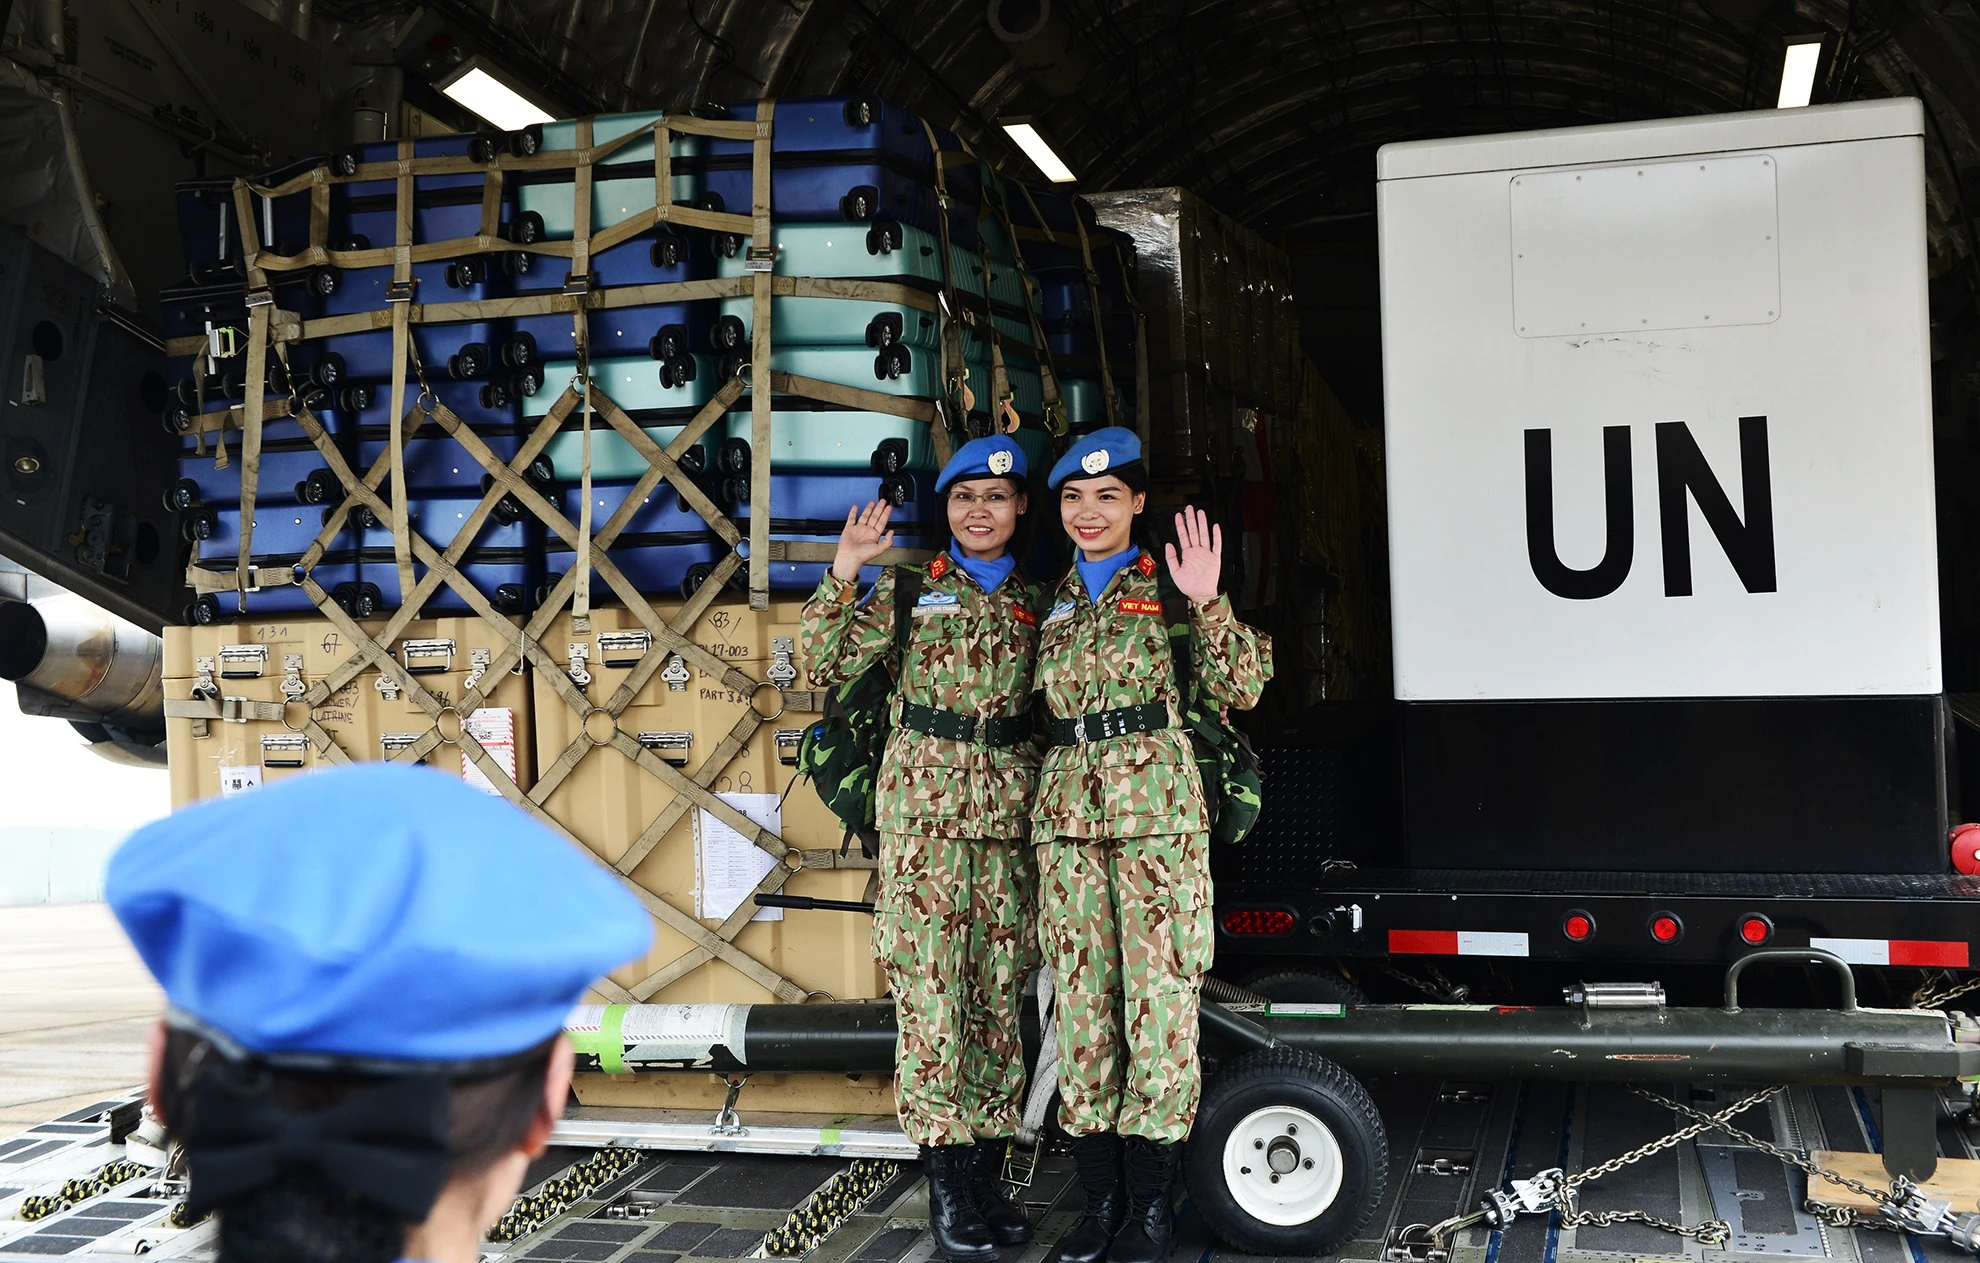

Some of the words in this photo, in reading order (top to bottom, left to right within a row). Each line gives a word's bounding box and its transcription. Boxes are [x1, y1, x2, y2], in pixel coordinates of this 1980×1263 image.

[1524, 415, 1778, 600] UN
[1141, 603, 1159, 611] NAM
[713, 611, 730, 629] 83
[257, 626, 288, 640] 131
[322, 633, 340, 657] 67
[700, 688, 725, 701] PART
[315, 709, 354, 724] LATRINE
